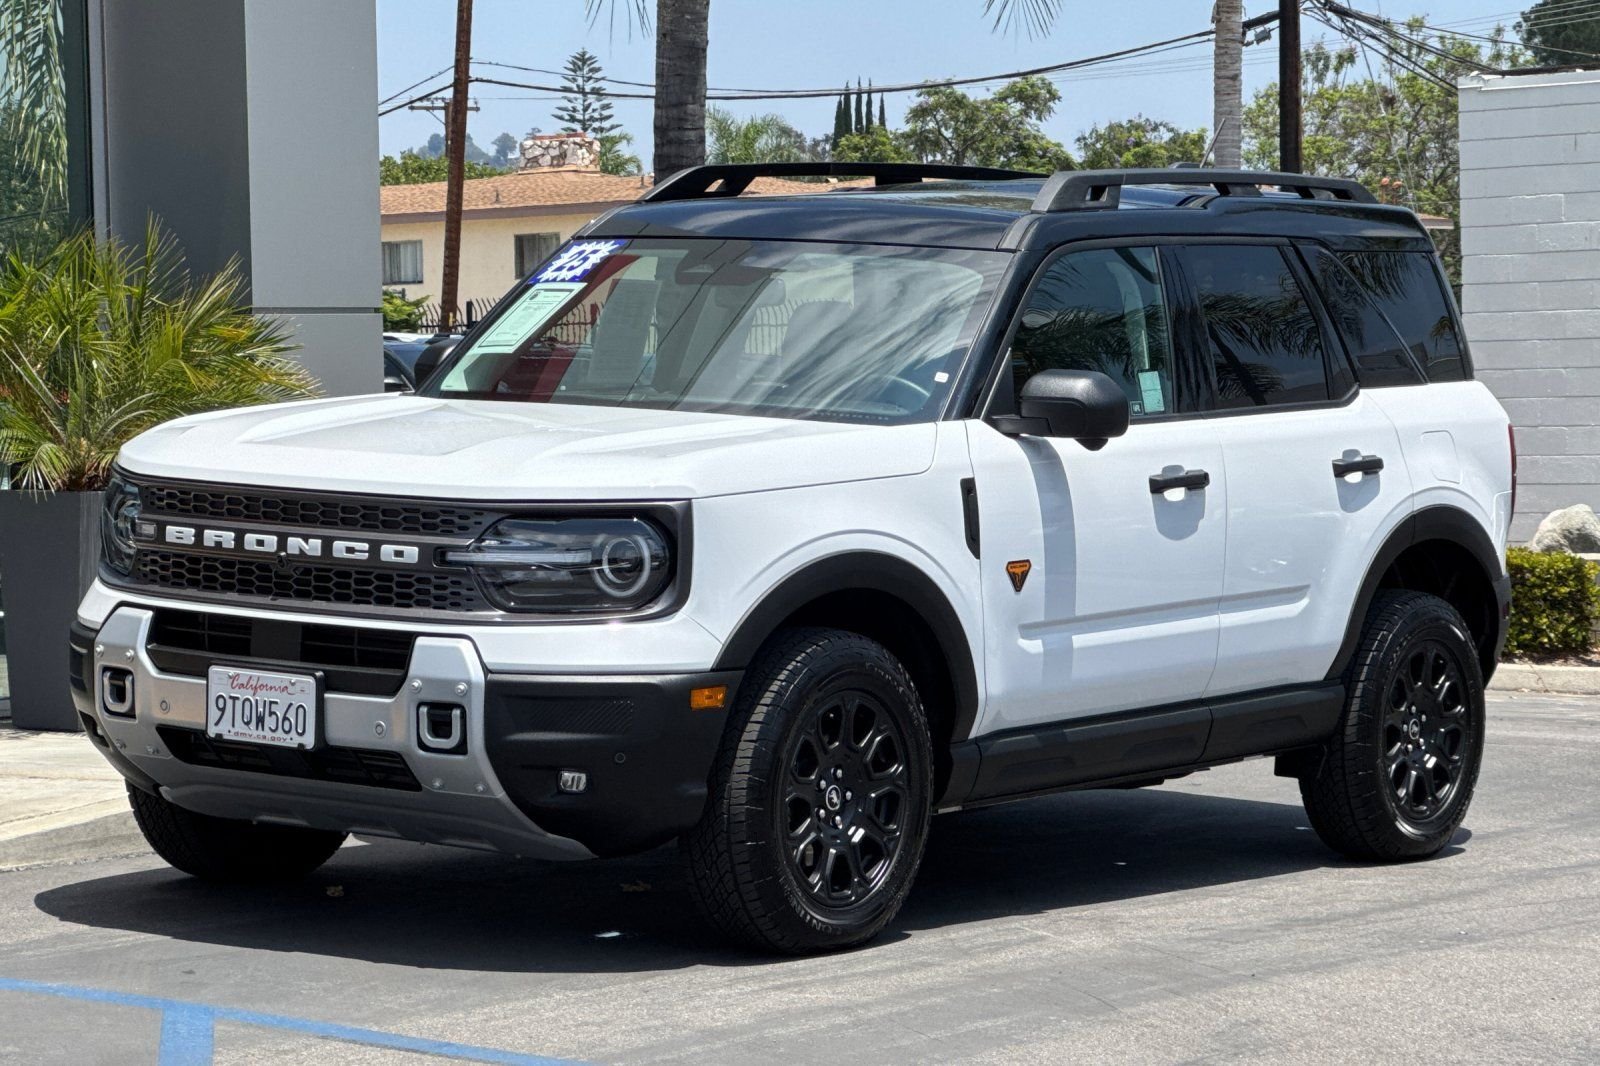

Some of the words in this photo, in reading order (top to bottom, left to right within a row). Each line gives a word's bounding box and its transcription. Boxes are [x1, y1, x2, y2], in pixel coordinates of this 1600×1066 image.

[550, 249, 601, 272] 25
[165, 525, 419, 563] BRONCO
[230, 673, 295, 696] California
[214, 694, 307, 737] 9TQW560
[233, 730, 288, 743] dmv.ca.gov
